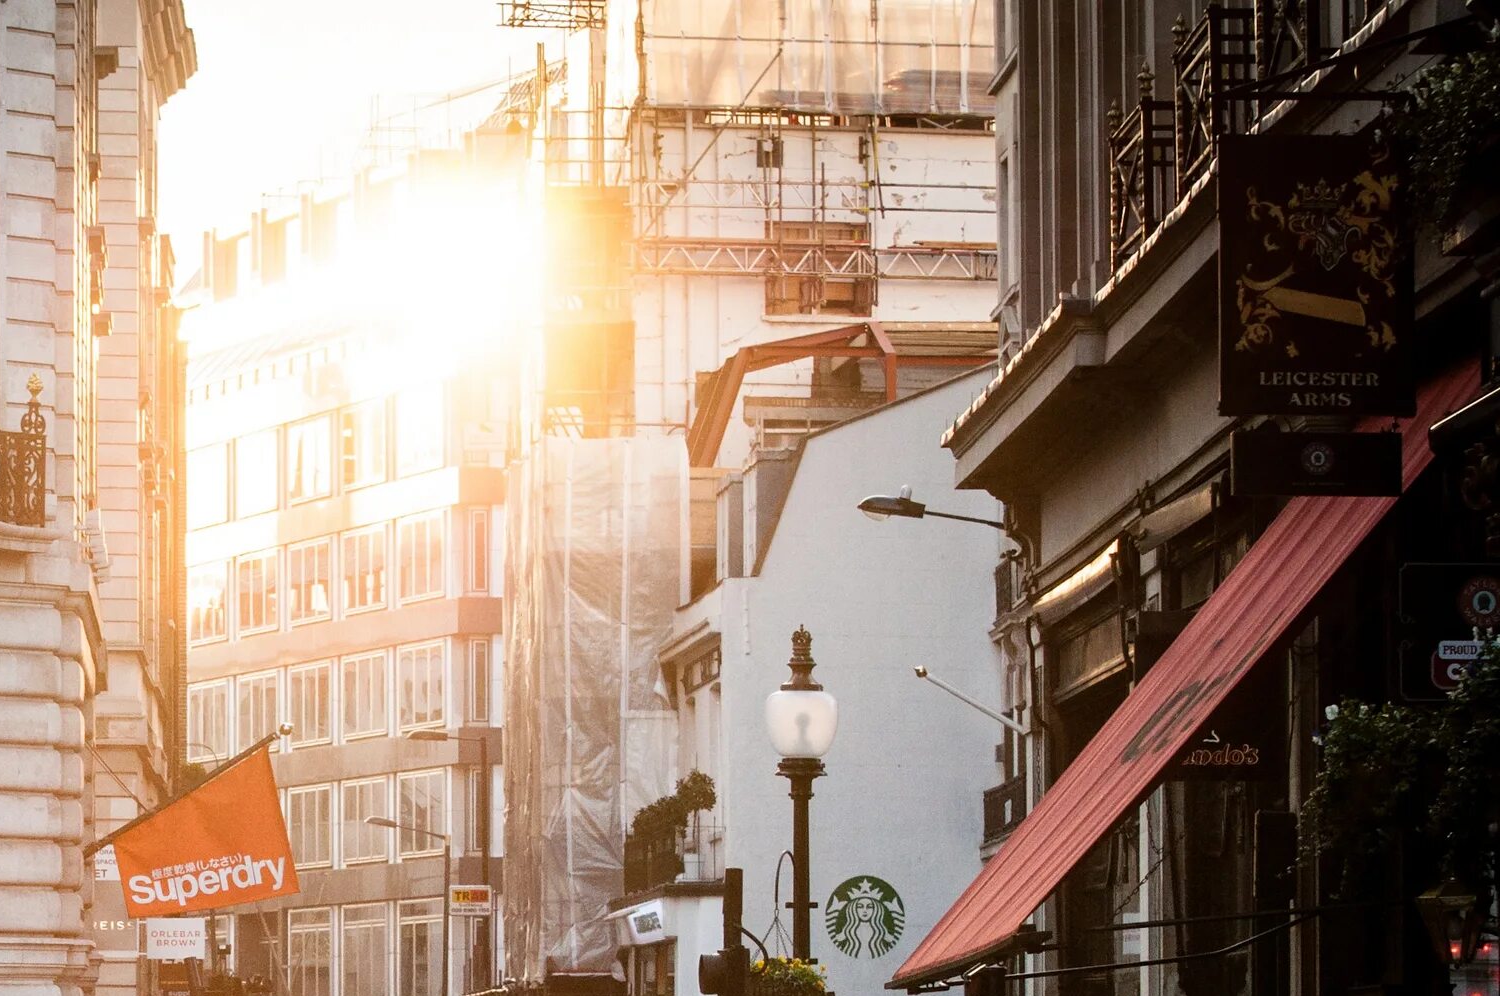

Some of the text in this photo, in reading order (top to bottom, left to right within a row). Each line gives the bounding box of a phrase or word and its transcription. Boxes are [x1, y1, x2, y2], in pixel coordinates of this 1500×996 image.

[1259, 371, 1380, 387] LEICESTER
[1287, 392, 1352, 407] ARMS
[1443, 645, 1478, 655] PROUD
[128, 855, 285, 906] Superdry
[151, 930, 201, 938] ORLEBAR
